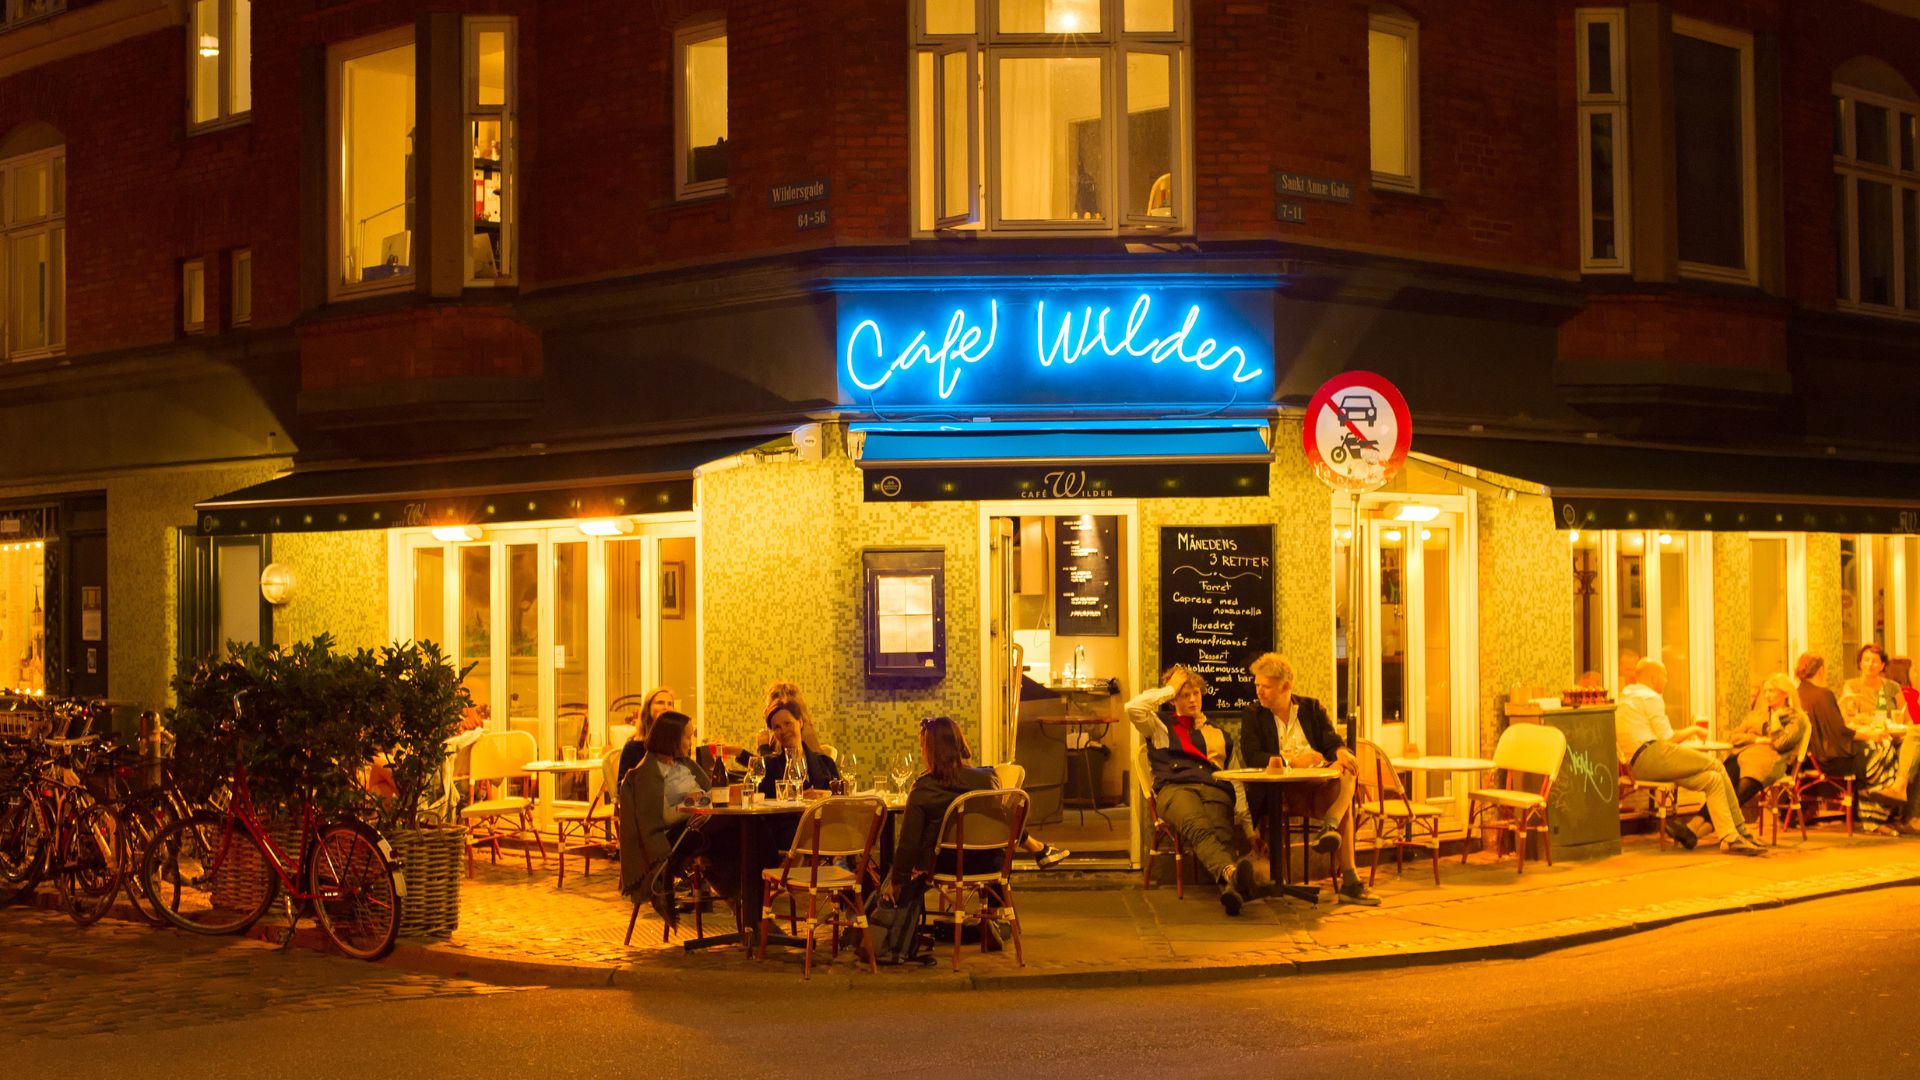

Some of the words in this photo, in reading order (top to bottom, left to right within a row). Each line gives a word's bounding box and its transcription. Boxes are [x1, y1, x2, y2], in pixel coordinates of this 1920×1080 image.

[772, 181, 824, 203] Wildersgade
[1281, 174, 1305, 192] Sankt
[1331, 182, 1350, 198] Gade
[1282, 204, 1303, 220] 7-11
[1036, 293, 1263, 384] Wilder
[1021, 489, 1047, 498] CAFÉ
[1044, 470, 1113, 498] WILDER
[1177, 532, 1238, 551] MÅNEDENS
[1209, 553, 1218, 566] 3
[1222, 555, 1270, 568] RETTER
[1172, 591, 1213, 605] Caprese
[1219, 597, 1239, 606] med
[1192, 617, 1235, 631] Hovedret
